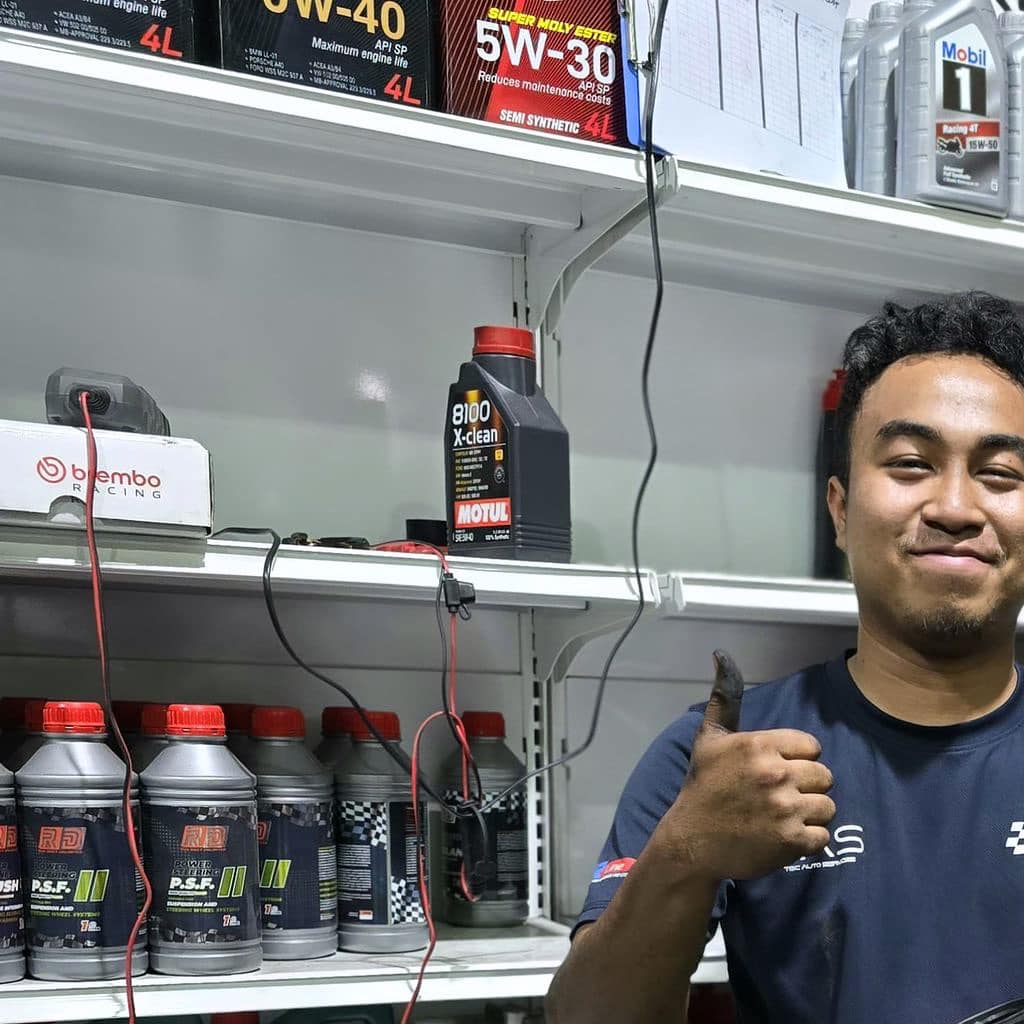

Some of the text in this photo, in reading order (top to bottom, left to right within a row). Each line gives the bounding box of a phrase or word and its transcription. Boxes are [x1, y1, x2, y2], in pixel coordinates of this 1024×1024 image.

[151, 5, 168, 19] life
[488, 8, 617, 43] SUPER MOLY ESTER
[140, 23, 183, 58] 4L
[375, 39, 408, 55] API SP
[476, 19, 616, 85] 5W-30
[311, 37, 410, 69] Maximum engine life
[942, 41, 986, 66] Mobil
[384, 73, 421, 105] 4L
[478, 71, 611, 105] Reduces maintenance costs
[578, 81, 610, 95] API SP
[500, 110, 580, 133] SEMI SYNTHETIC
[584, 112, 616, 141] 4L
[943, 124, 979, 135] Racing 4T
[969, 139, 998, 150] 15W-50
[452, 400, 491, 425] 8100
[453, 427, 498, 447] X-clean
[72, 463, 161, 488] bembo
[457, 502, 509, 524] MOTUL
[31, 879, 71, 893] P.S.F.
[169, 877, 215, 889] P.S.F.
